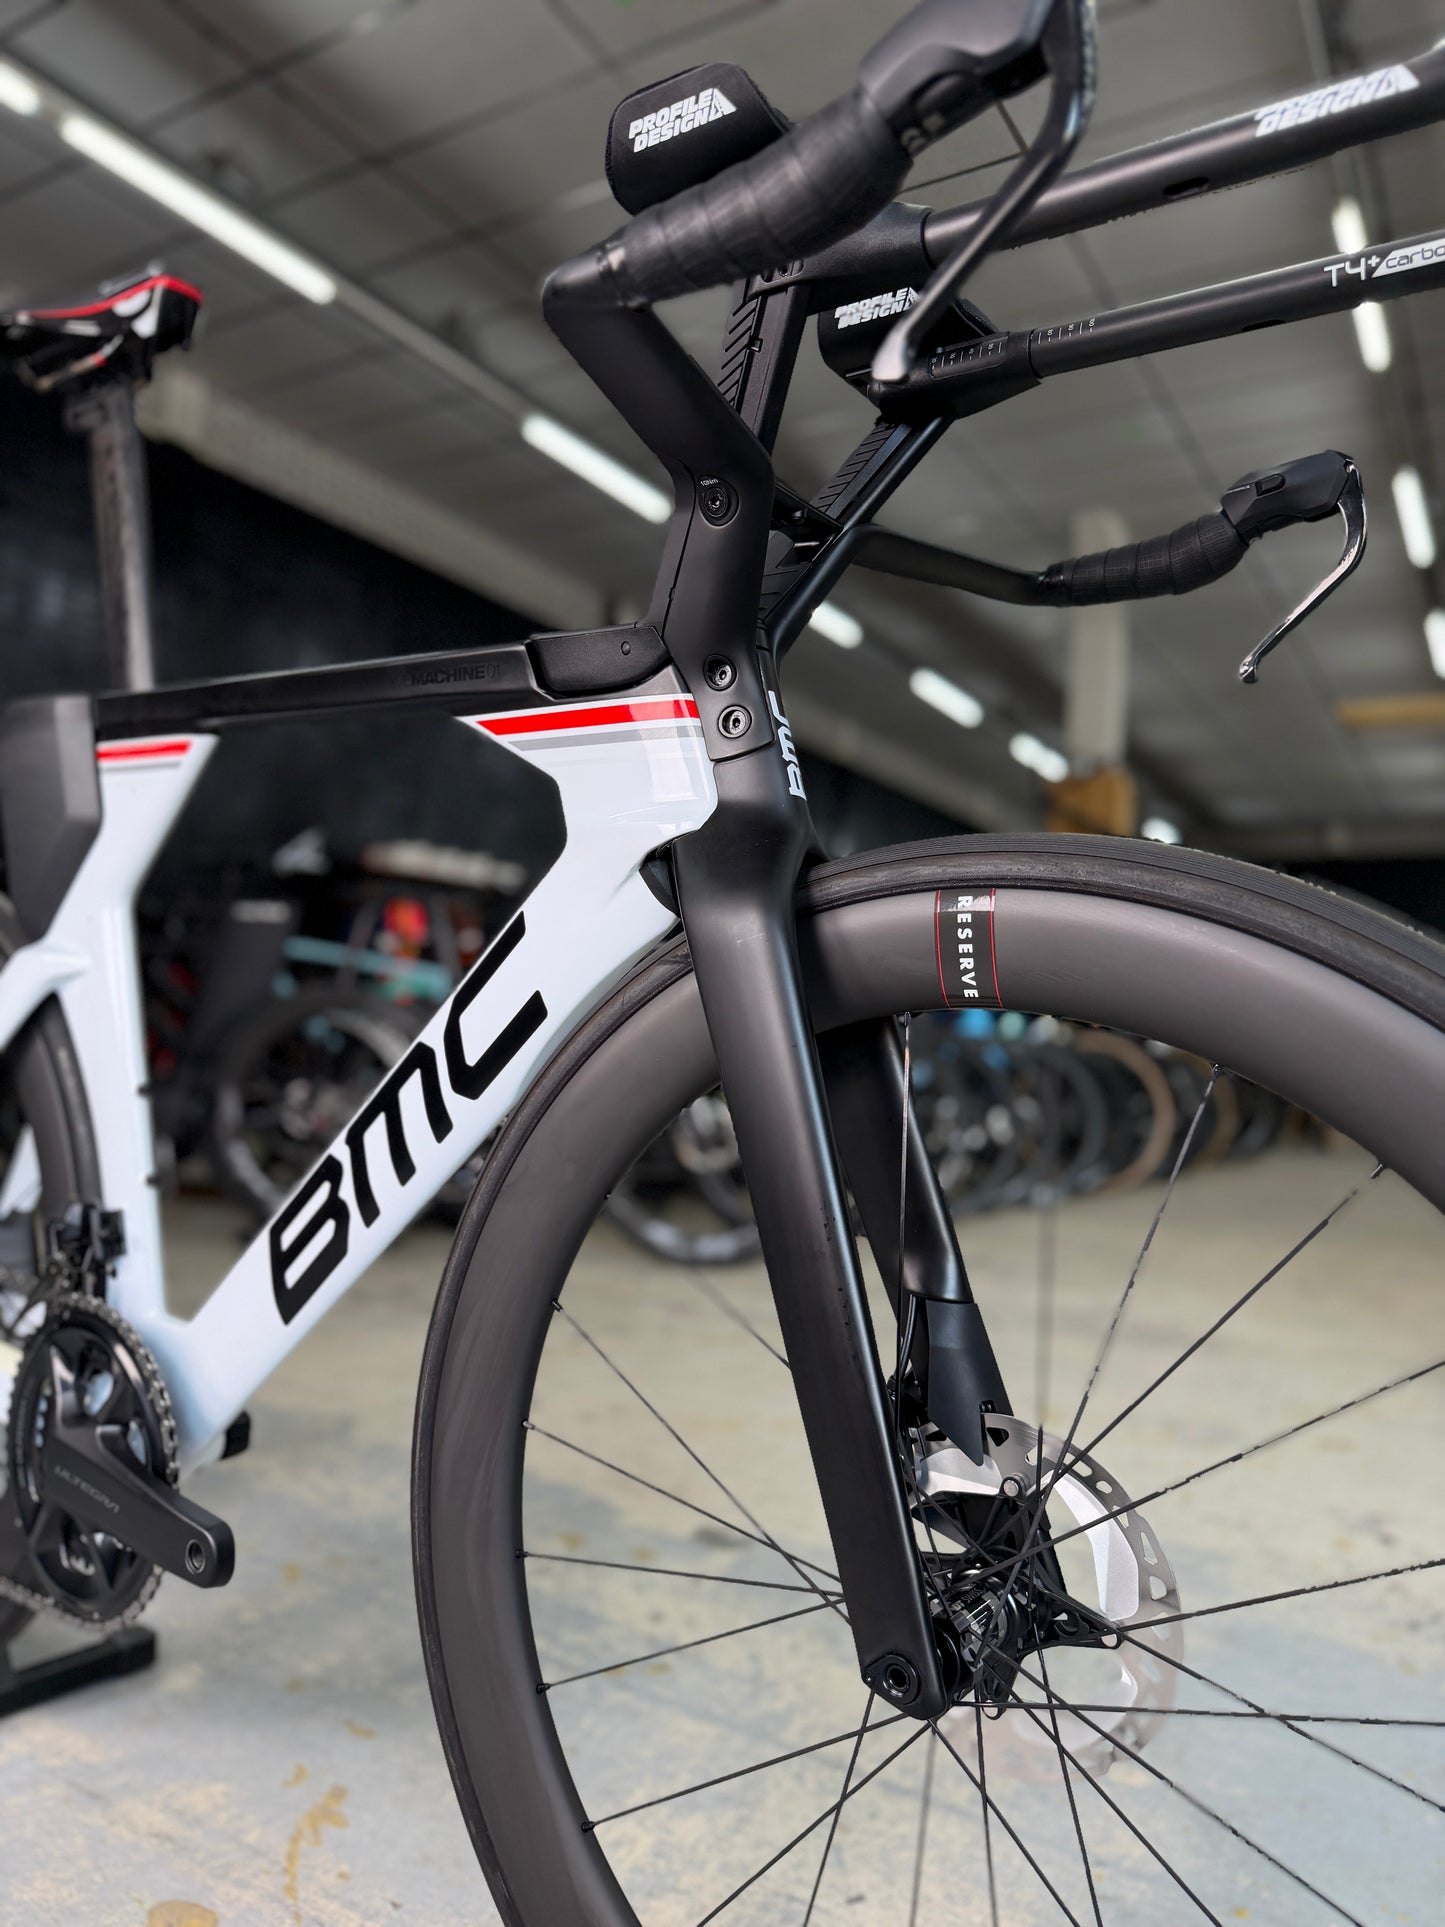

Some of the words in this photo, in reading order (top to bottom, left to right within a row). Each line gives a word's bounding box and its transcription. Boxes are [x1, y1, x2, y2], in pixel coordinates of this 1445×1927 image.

[629, 88, 713, 139] PROFILE
[633, 106, 712, 153] DESIGN
[834, 287, 909, 319] PROFILE
[838, 300, 905, 329] DESIGN
[957, 895, 979, 998] RESERVE
[269, 910, 548, 1326] BMC
